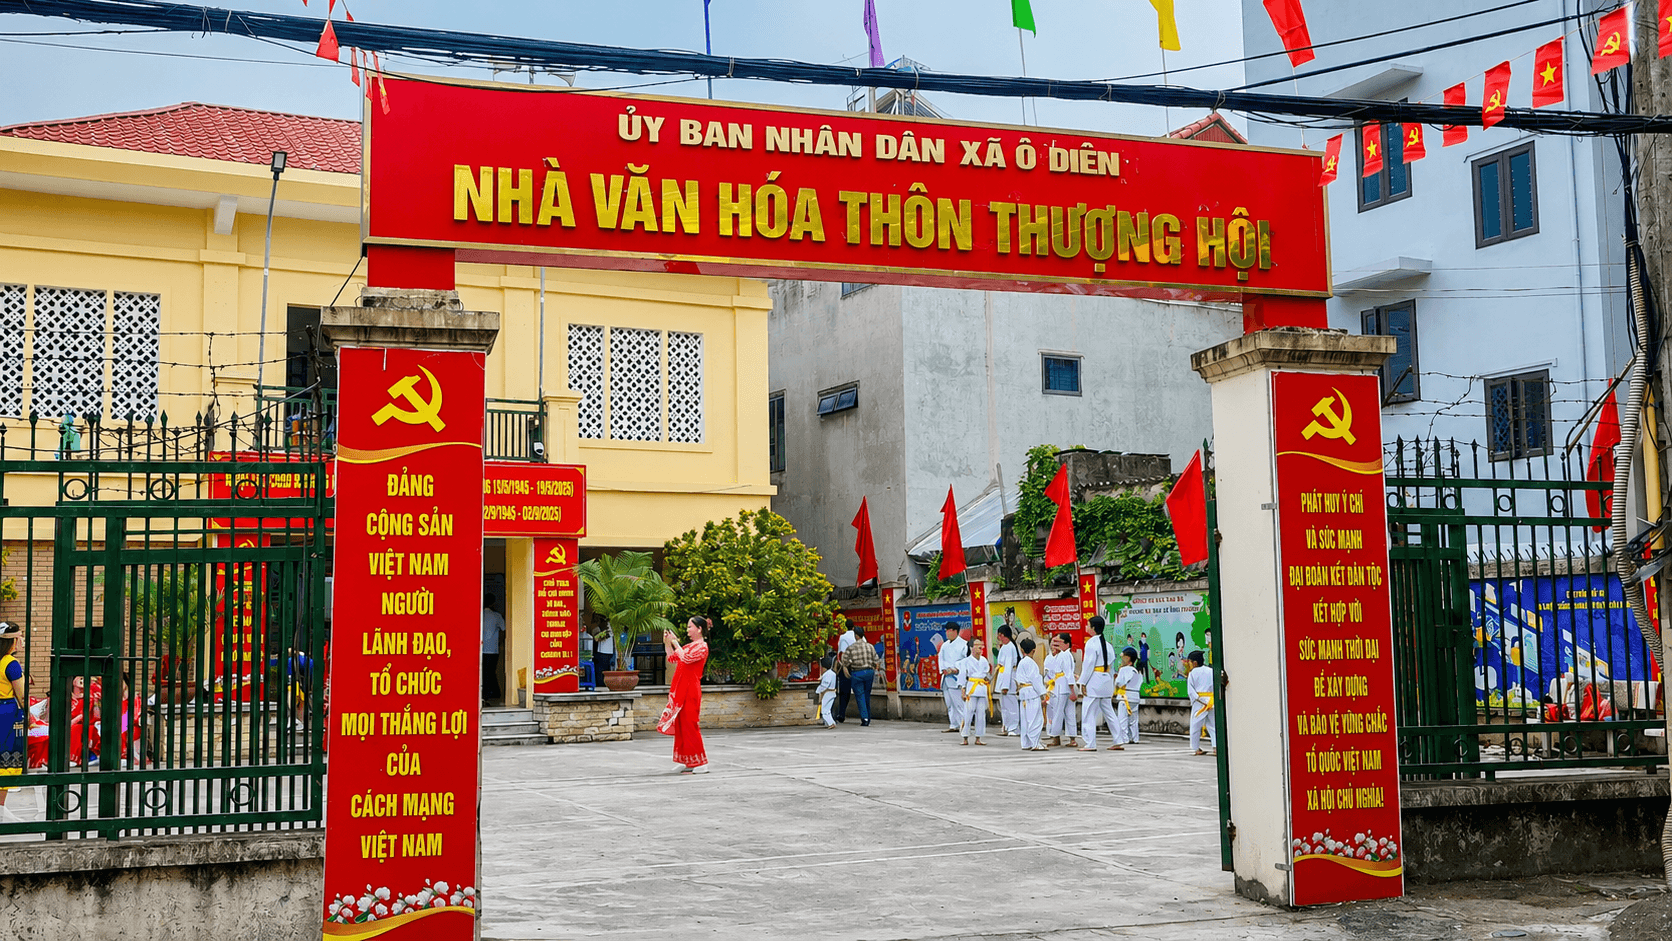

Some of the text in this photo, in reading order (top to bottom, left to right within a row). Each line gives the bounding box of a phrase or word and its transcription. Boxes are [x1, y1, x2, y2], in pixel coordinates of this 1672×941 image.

[618, 105, 666, 143] ỦY
[679, 119, 753, 149] BAN
[765, 124, 863, 159] NHÂN
[876, 130, 946, 165] DÂN
[959, 137, 1007, 168] XÃ
[1015, 137, 1037, 170] Ô
[453, 156, 1272, 281] NHÀ VĂN HÓA THÔN THƯỢNG HỘI
[387, 466, 434, 497] ĐẢNG
[1301, 488, 1364, 513] PHÁT HUY Ý CHÍ
[366, 506, 453, 540] CỘNG SẢN
[1306, 525, 1317, 549] VÀ
[1337, 529, 1363, 554] MẠNH
[368, 548, 449, 580] VIỆT NAM
[1289, 565, 1303, 591] ĐẠI
[1330, 560, 1345, 586] KẾT
[1366, 562, 1382, 590] TỘC
[381, 586, 434, 615] NGƯỜI
[1313, 596, 1328, 623] KẾT
[1330, 600, 1346, 627] HỢP
[362, 628, 452, 660] LÃNH ĐẠO,
[1318, 639, 1343, 664] MẠNH
[1345, 634, 1363, 659] THỜI
[370, 663, 442, 695] TỔ CHỨC
[341, 704, 468, 741] MỌI THẮNG LỢI
[1310, 708, 1327, 734] BẢO
[1365, 705, 1388, 733] CHẮC
[386, 744, 422, 777] CỦA
[1319, 744, 1341, 776] QUỐC
[1342, 746, 1360, 775] VIỆT
[1362, 750, 1382, 770] NAM
[350, 789, 455, 821] CÁCH MẠNG
[1321, 784, 1335, 814] HỘI
[1337, 783, 1354, 809] CHỦ
[360, 829, 443, 864] VIỆT NAM
